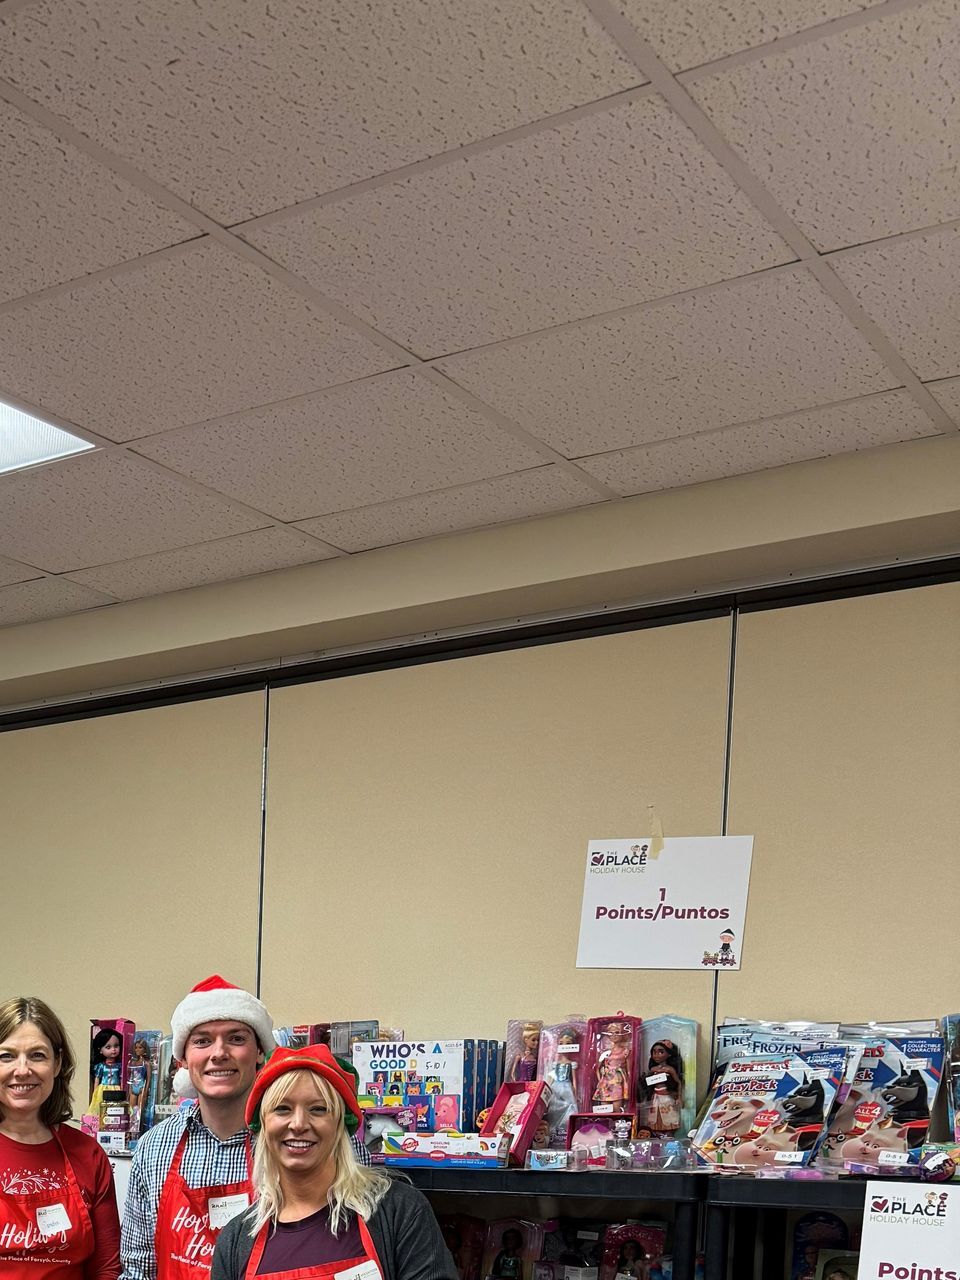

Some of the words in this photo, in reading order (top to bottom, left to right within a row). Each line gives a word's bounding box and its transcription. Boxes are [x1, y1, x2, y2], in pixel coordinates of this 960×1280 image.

[605, 854, 647, 866] PLACE
[589, 867, 620, 875] HOLIDAY
[621, 866, 646, 874] HOUSE
[658, 887, 667, 902] 1
[595, 903, 730, 921] Points/Puntos
[751, 1041, 802, 1054] FROZEN
[901, 1044, 907, 1054] 1
[369, 1059, 407, 1070] GOOD
[721, 1082, 749, 1093] Play
[749, 1080, 778, 1090] Pack
[769, 1112, 780, 1121] 4
[872, 1106, 882, 1115] 4
[891, 1201, 947, 1217] PLACE
[869, 1214, 911, 1224] HOLIDAY
[912, 1217, 945, 1227] HOUSE
[30, 1256, 51, 1264] Forsyth
